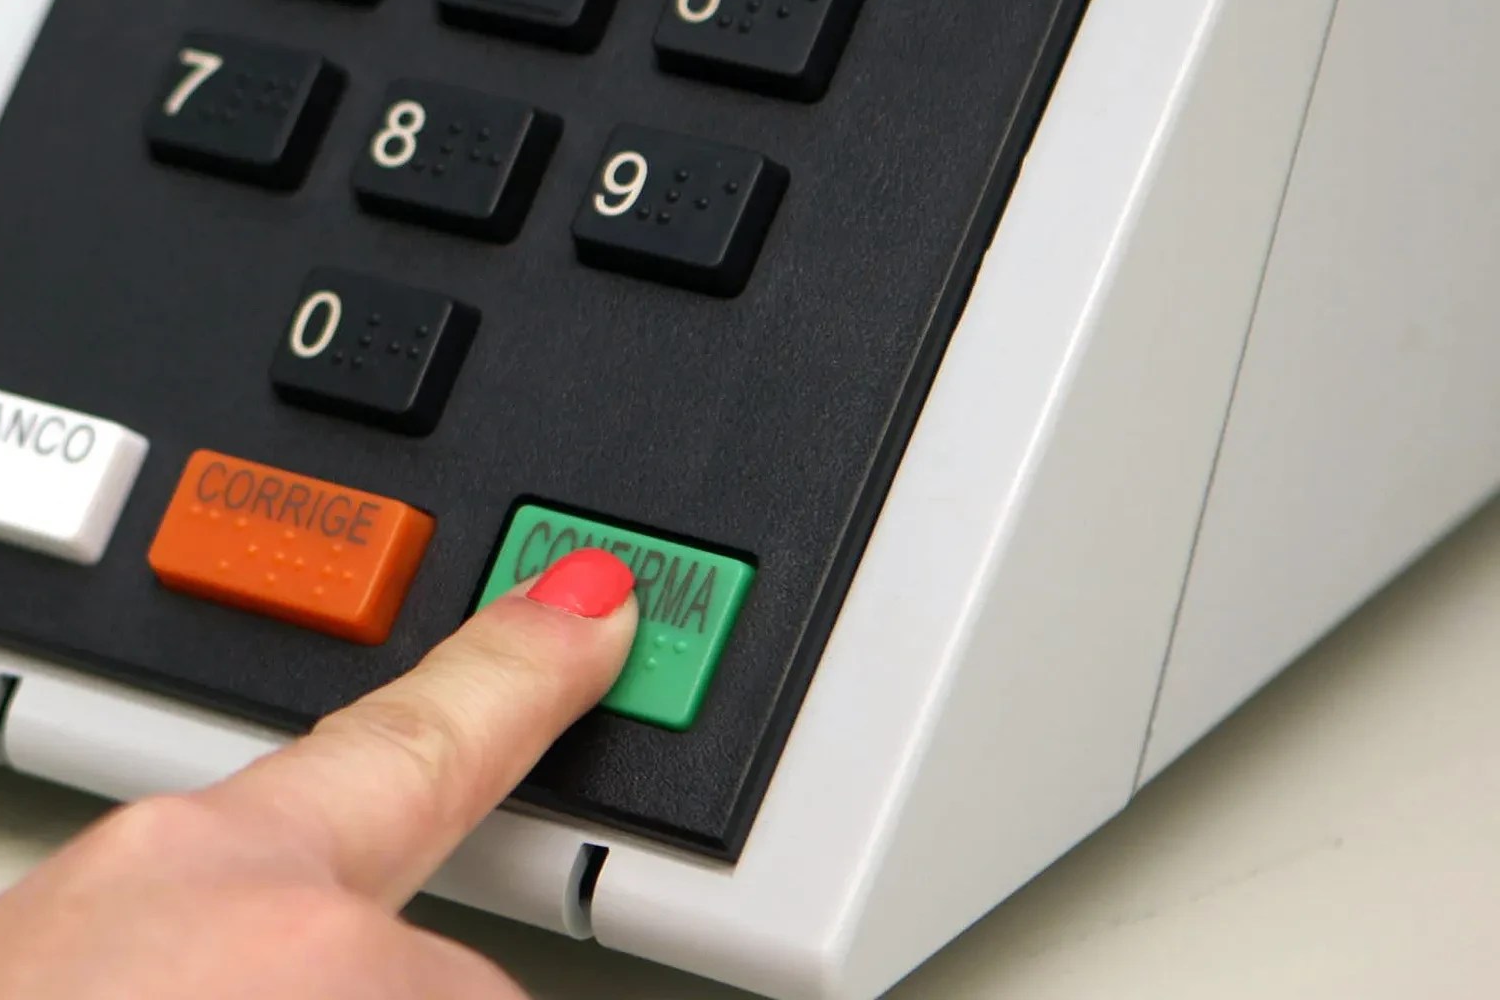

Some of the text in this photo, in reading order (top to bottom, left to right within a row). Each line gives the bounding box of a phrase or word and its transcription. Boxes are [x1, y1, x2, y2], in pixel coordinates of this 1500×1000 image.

[164, 48, 224, 116] 7
[371, 99, 427, 169] 8
[592, 150, 649, 218] 9
[289, 290, 343, 359] 0
[197, 461, 381, 546] CORRIGE
[513, 520, 717, 634] CORMA
